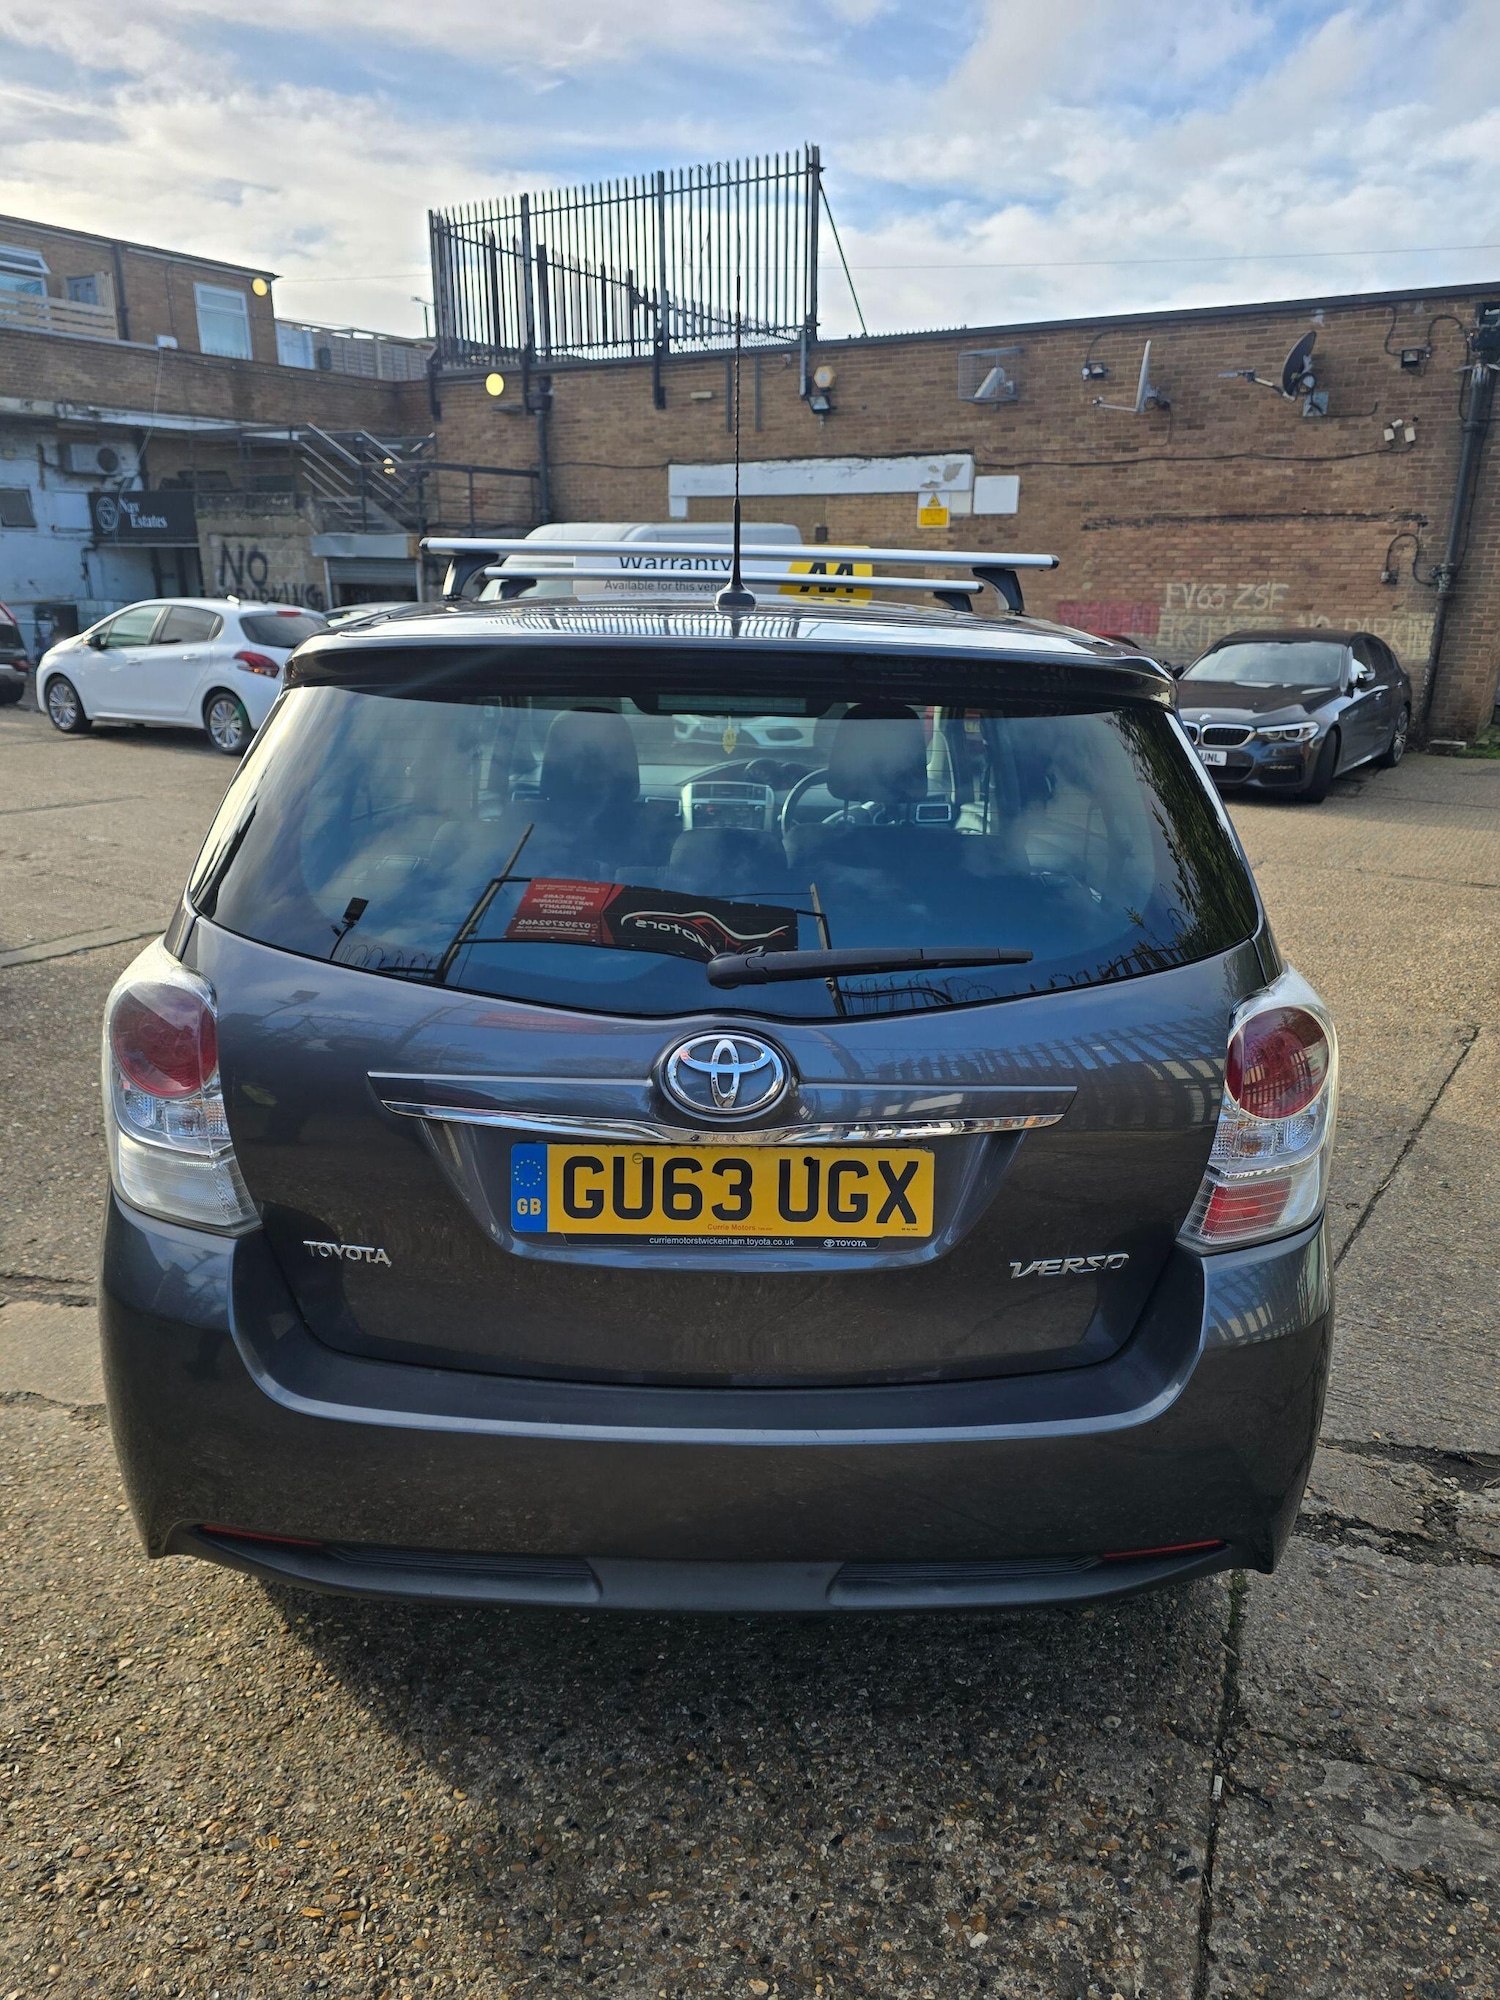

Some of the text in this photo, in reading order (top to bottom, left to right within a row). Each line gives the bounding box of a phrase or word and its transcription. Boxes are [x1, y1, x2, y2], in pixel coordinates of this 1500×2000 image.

[130, 514, 168, 529] Estates
[219, 541, 269, 588] NO
[620, 556, 732, 571] Warranty
[604, 580, 655, 590] Available
[657, 581, 673, 591] for
[675, 582, 695, 591] this
[1166, 582, 1227, 609] FV63
[562, 1155, 919, 1224] GU63 UGX
[516, 1198, 542, 1216] GB
[707, 1223, 730, 1231] Currie
[649, 1236, 795, 1247] curriemotorstwickenham.toyota.co.uk
[835, 1239, 868, 1248] TOYOTA
[303, 1240, 392, 1268] TOYOTA
[1009, 1252, 1130, 1279] VERSO
